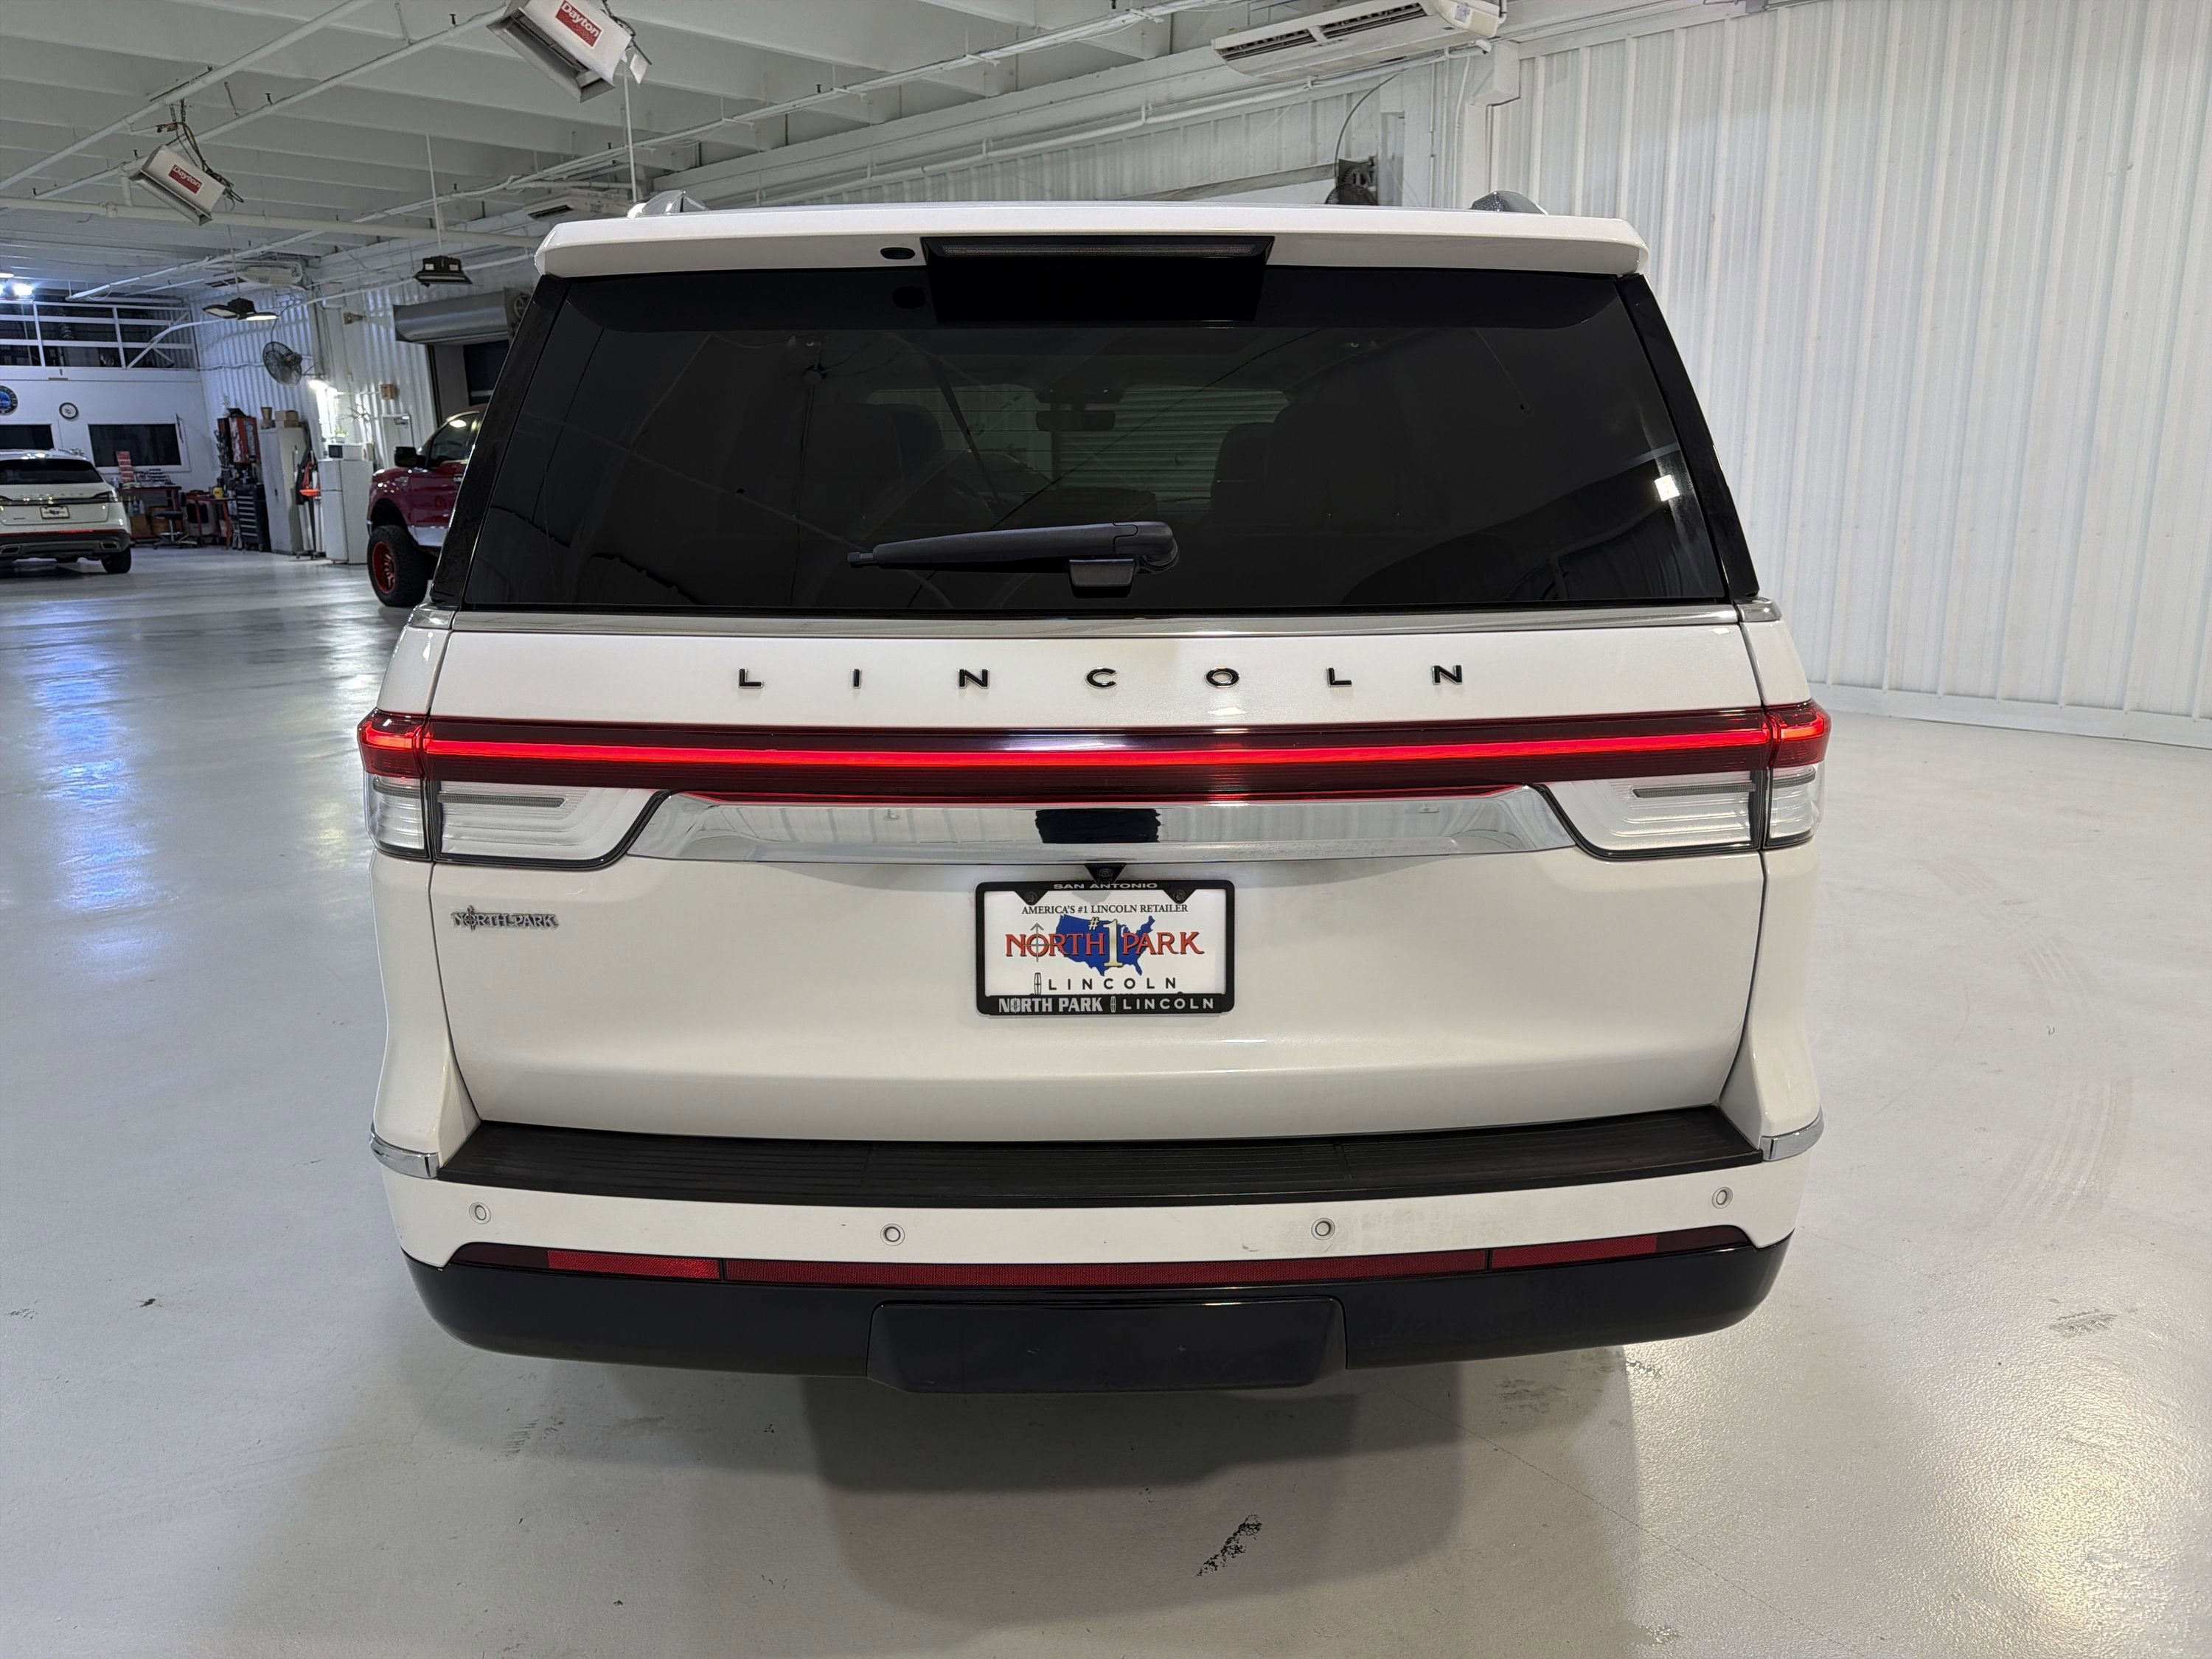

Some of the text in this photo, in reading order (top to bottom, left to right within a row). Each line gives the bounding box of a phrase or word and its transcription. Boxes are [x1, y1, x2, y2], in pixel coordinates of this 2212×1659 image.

[561, 2, 599, 38] Dayton
[173, 166, 201, 188] Dayton
[738, 664, 1464, 689] LINCOLN
[1021, 904, 1189, 915] AMERICA'S #1 LINCOLN RETAILER
[451, 912, 559, 928] NORTH PARK
[1005, 931, 1206, 957] NORTH PARK
[1048, 977, 1177, 991] LINCOLN
[998, 997, 1214, 1013] NORTH PARK LINCOLN
